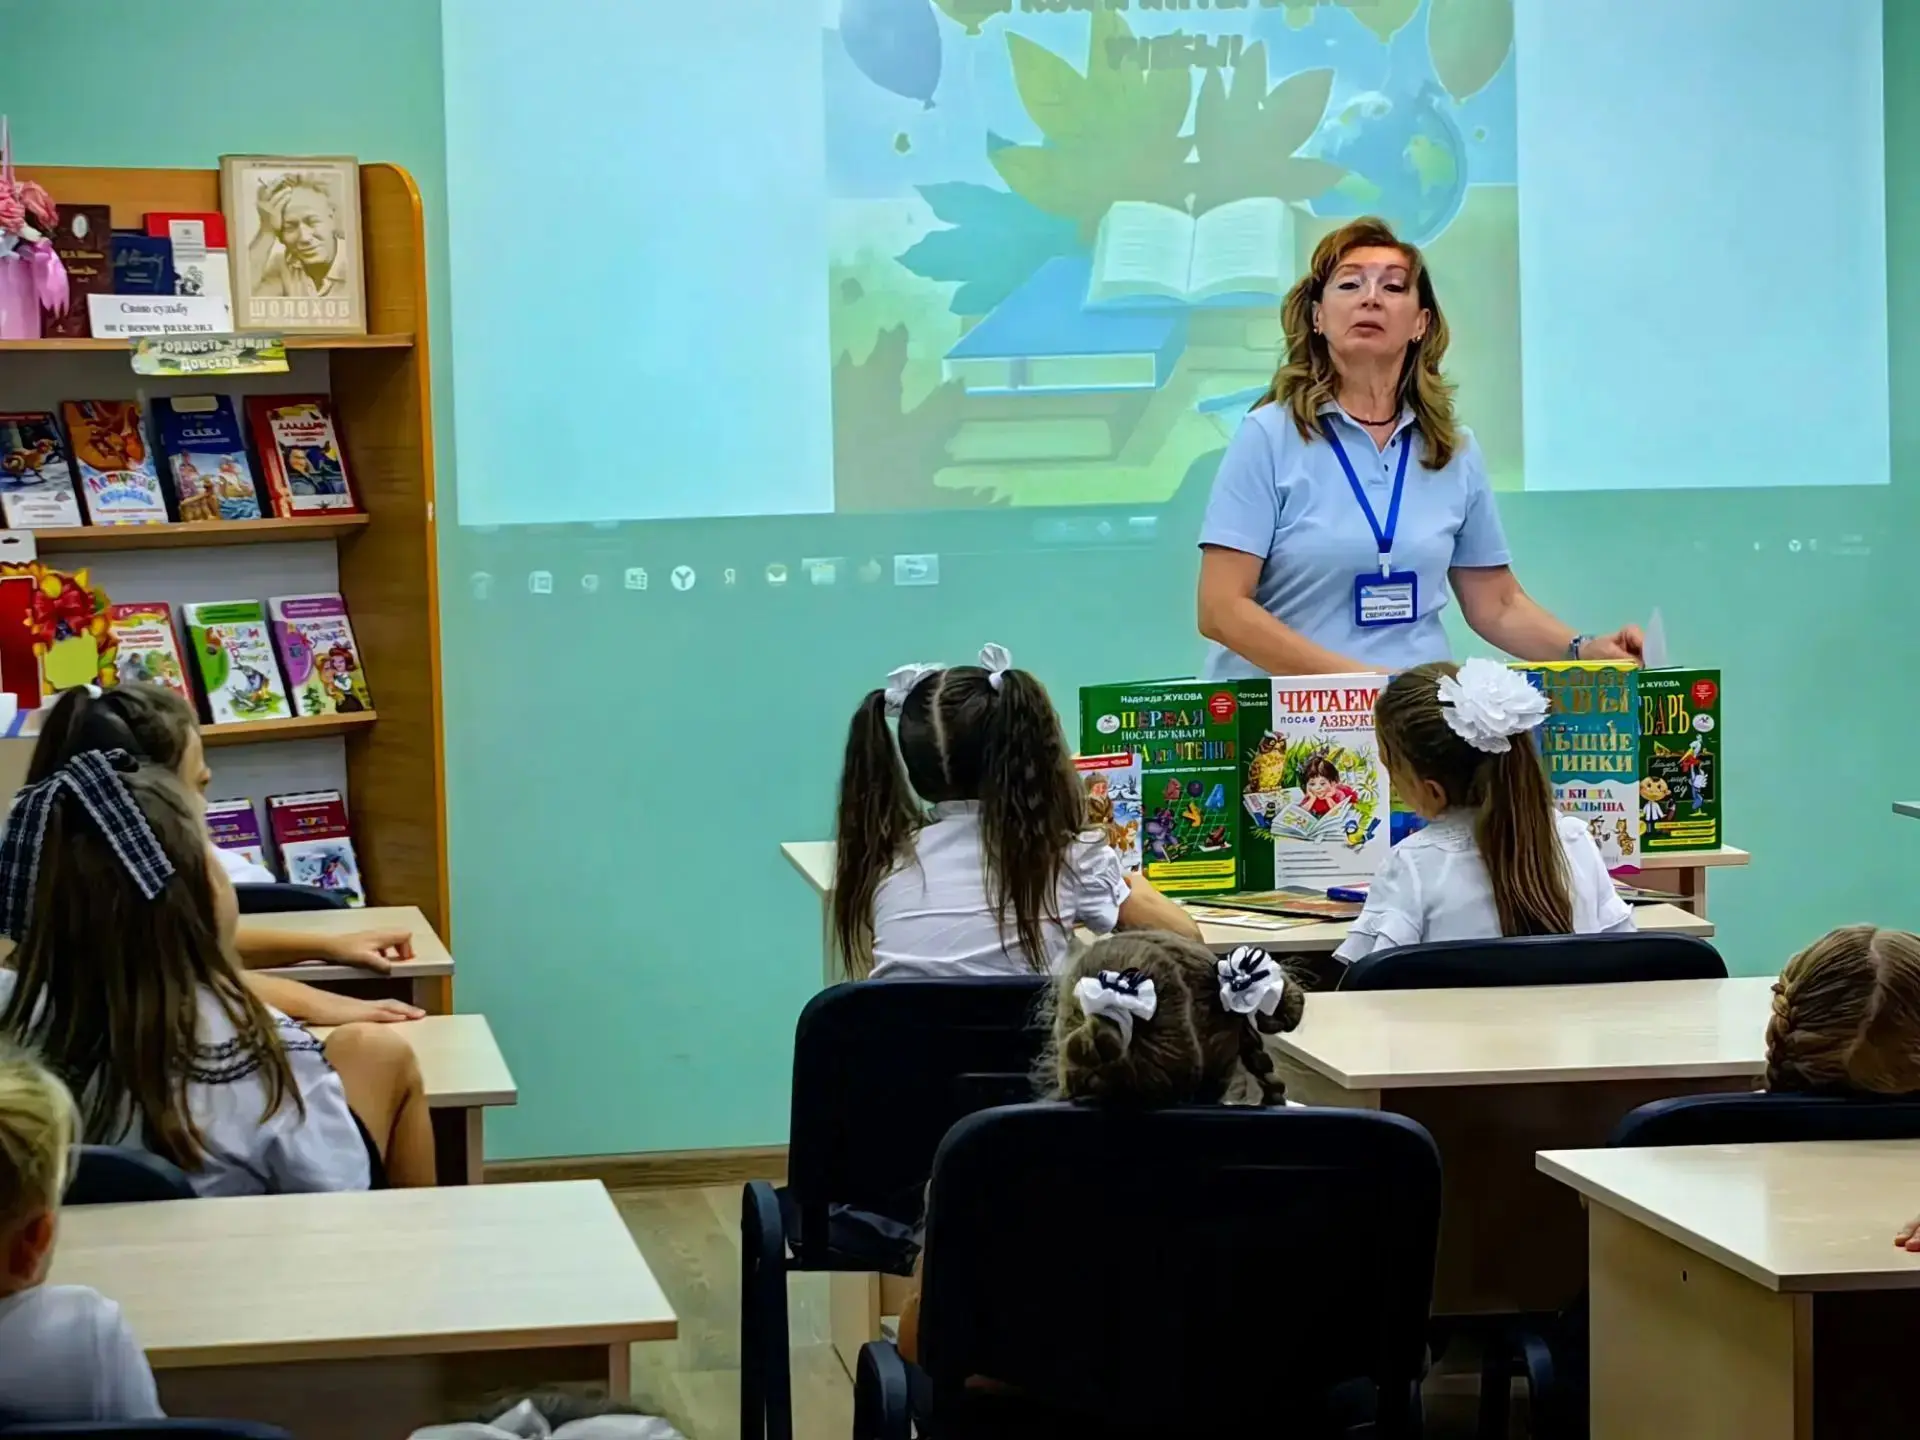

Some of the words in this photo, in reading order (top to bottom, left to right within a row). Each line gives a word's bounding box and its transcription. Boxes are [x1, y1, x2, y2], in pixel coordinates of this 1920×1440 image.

[120, 303, 150, 314] Свою
[153, 303, 189, 317] судьбу
[250, 301, 349, 317] ШОЛОХОВ
[179, 355, 240, 372] Донской
[1120, 694, 1162, 704] Надежда
[1164, 693, 1203, 702] ЖУКОВА
[1278, 688, 1380, 713] ЧИТАЕМ
[1121, 708, 1204, 730] ПЕРВАЯ
[1638, 694, 1690, 736] ВАРЬ
[1121, 730, 1157, 741] ПОСЛЕ
[1158, 728, 1206, 740] БУКВАРЯ
[1175, 740, 1235, 762] ЧТЕНИЯ
[1552, 755, 1633, 772] ТИНКИ
[1568, 789, 1613, 799] КНИГА
[1560, 802, 1625, 812] МАЛЫША
